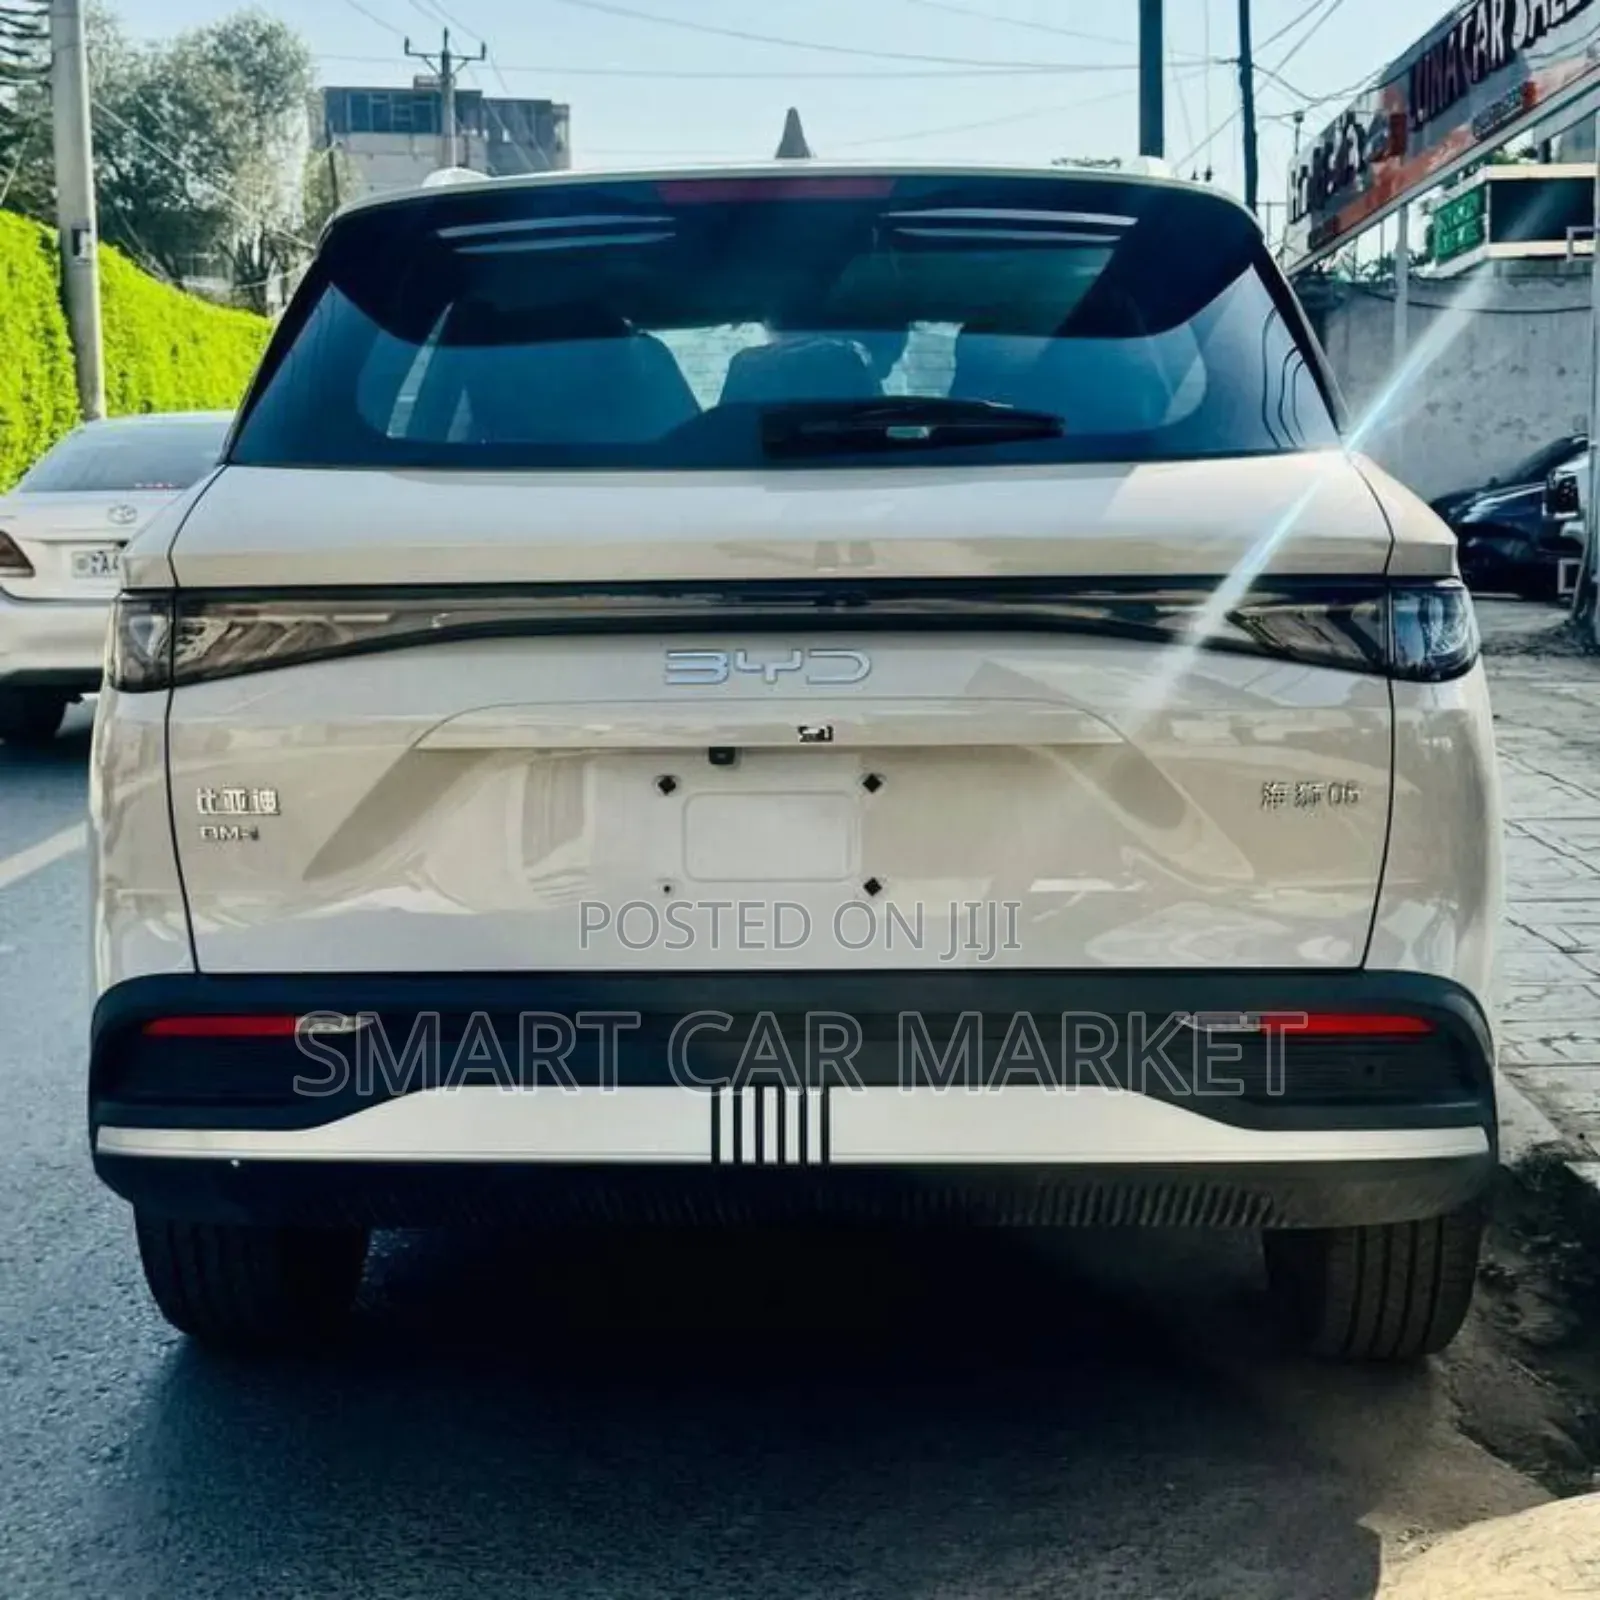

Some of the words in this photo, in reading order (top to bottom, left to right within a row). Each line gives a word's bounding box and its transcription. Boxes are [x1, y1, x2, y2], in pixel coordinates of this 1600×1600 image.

[664, 648, 872, 685] BYD
[196, 786, 281, 816] 比亚迪
